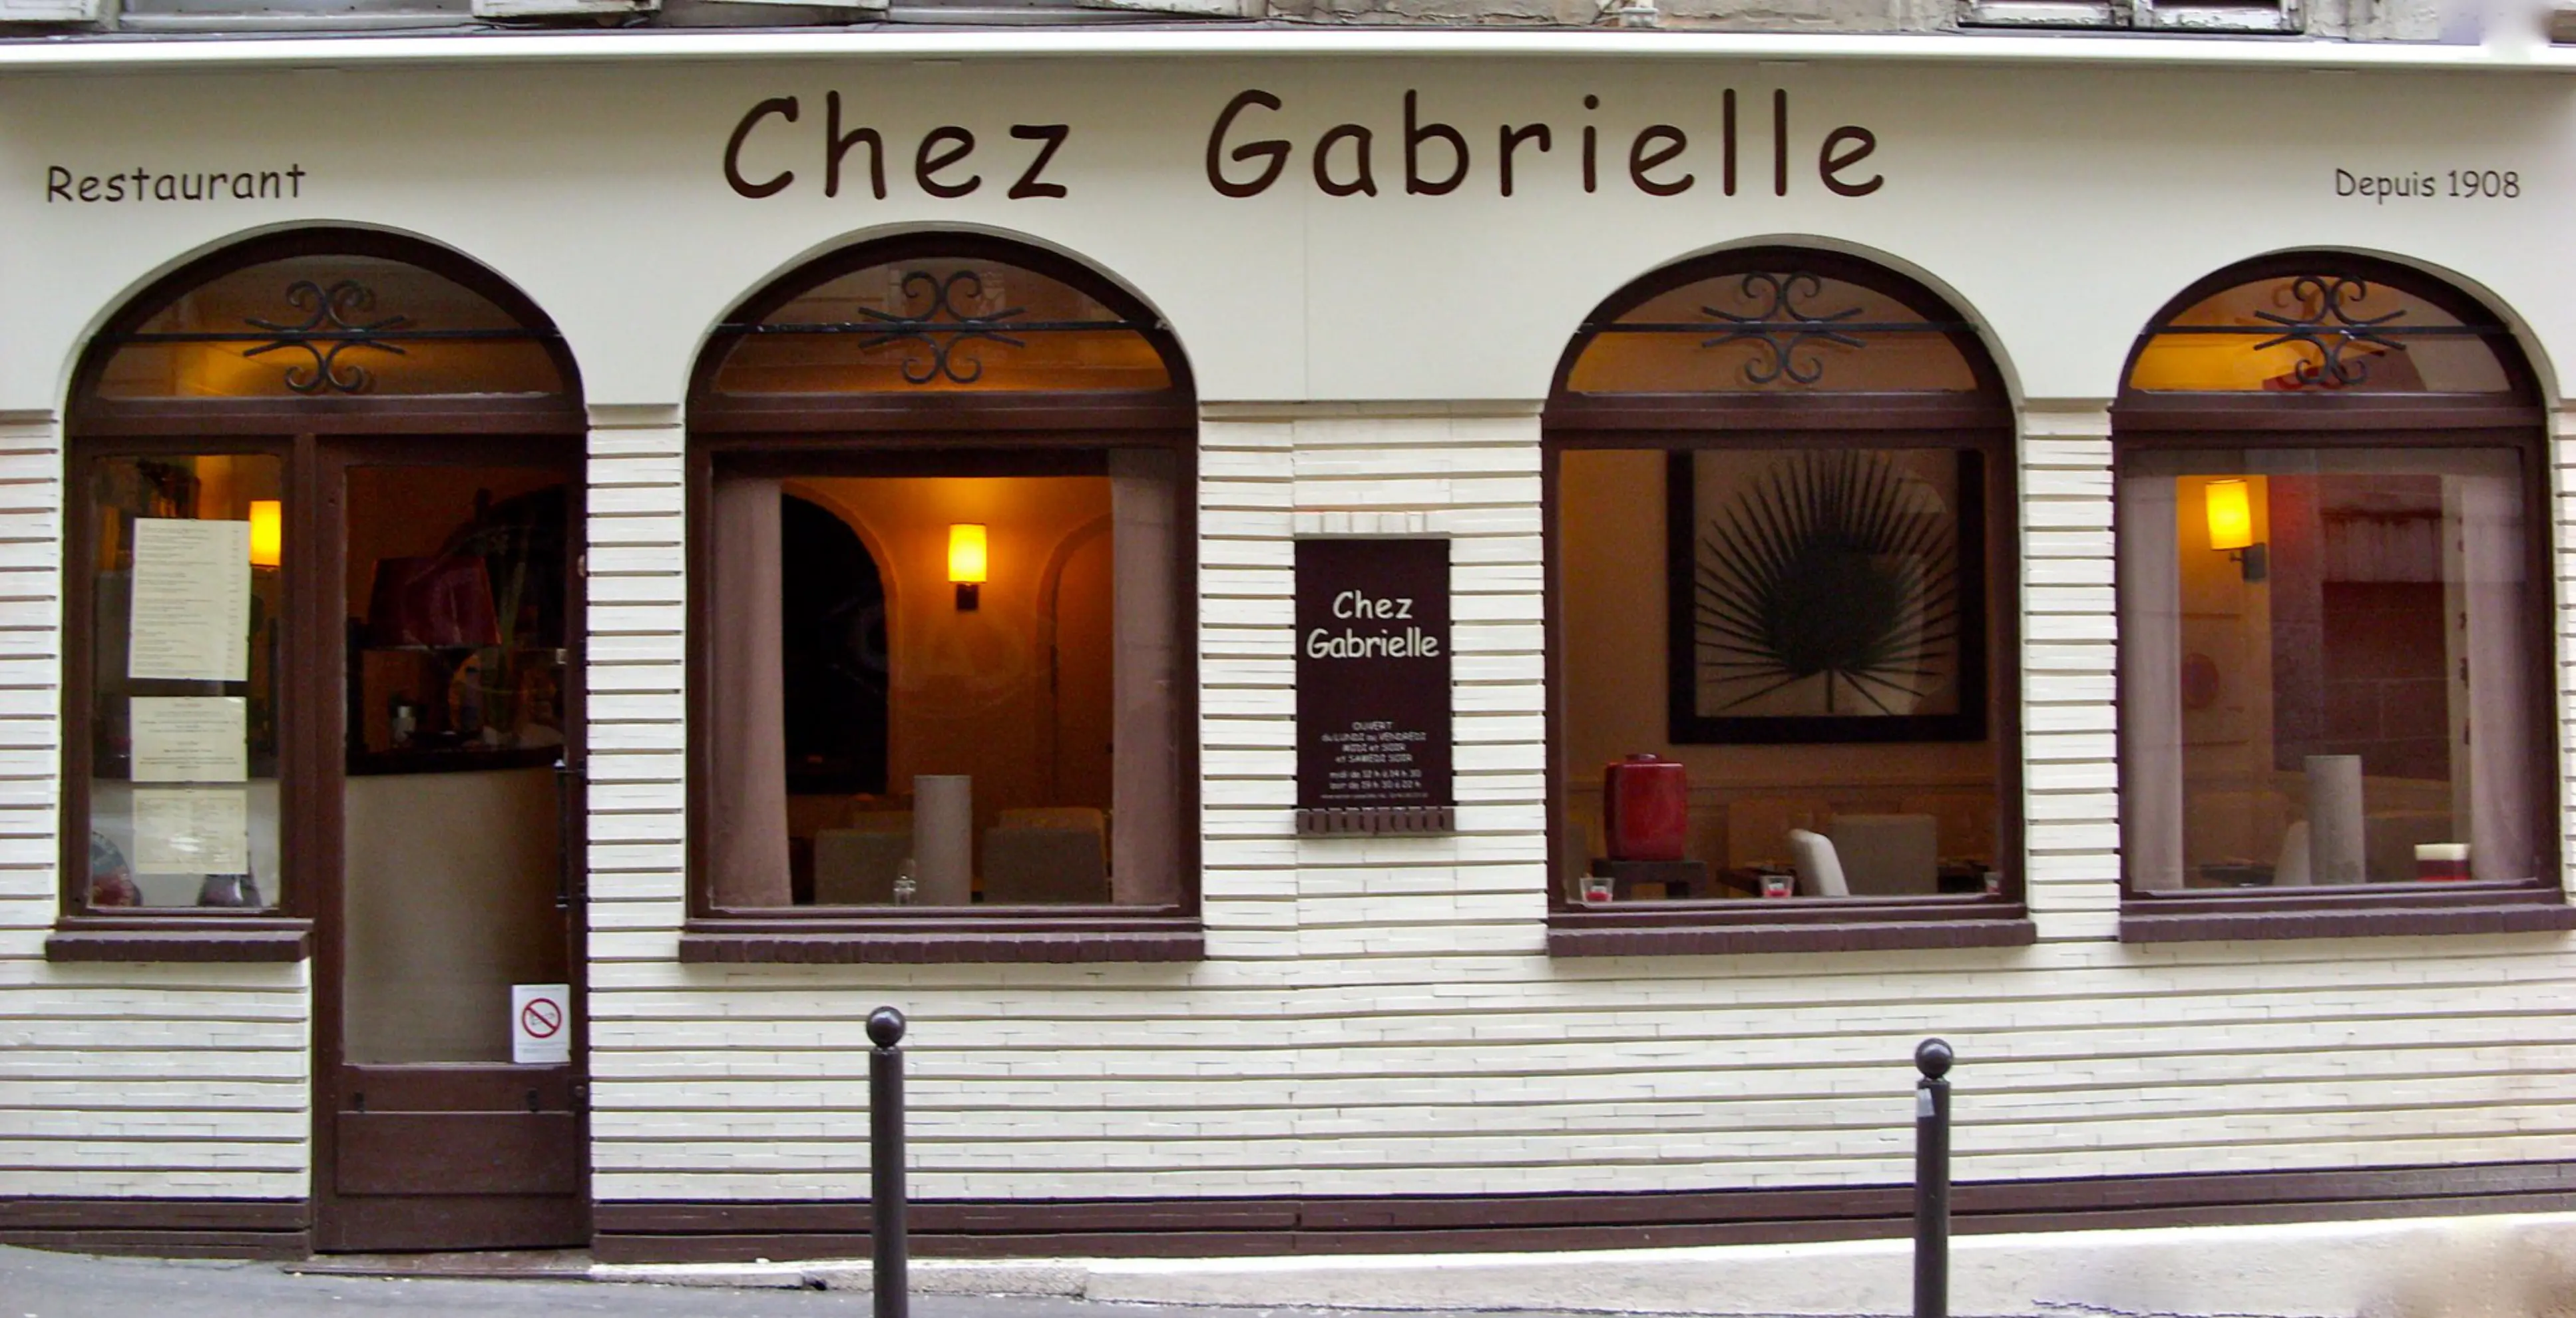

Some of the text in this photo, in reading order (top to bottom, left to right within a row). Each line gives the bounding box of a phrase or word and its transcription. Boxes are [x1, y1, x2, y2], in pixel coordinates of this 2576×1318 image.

[724, 89, 1884, 200] Chez Gabrielle
[47, 164, 307, 202] Restaurant
[2336, 168, 2521, 205] Depuis 1908
[1333, 590, 1413, 619] Chez
[1307, 626, 1440, 658] Gabrielle
[1352, 721, 1394, 731] OUVERT
